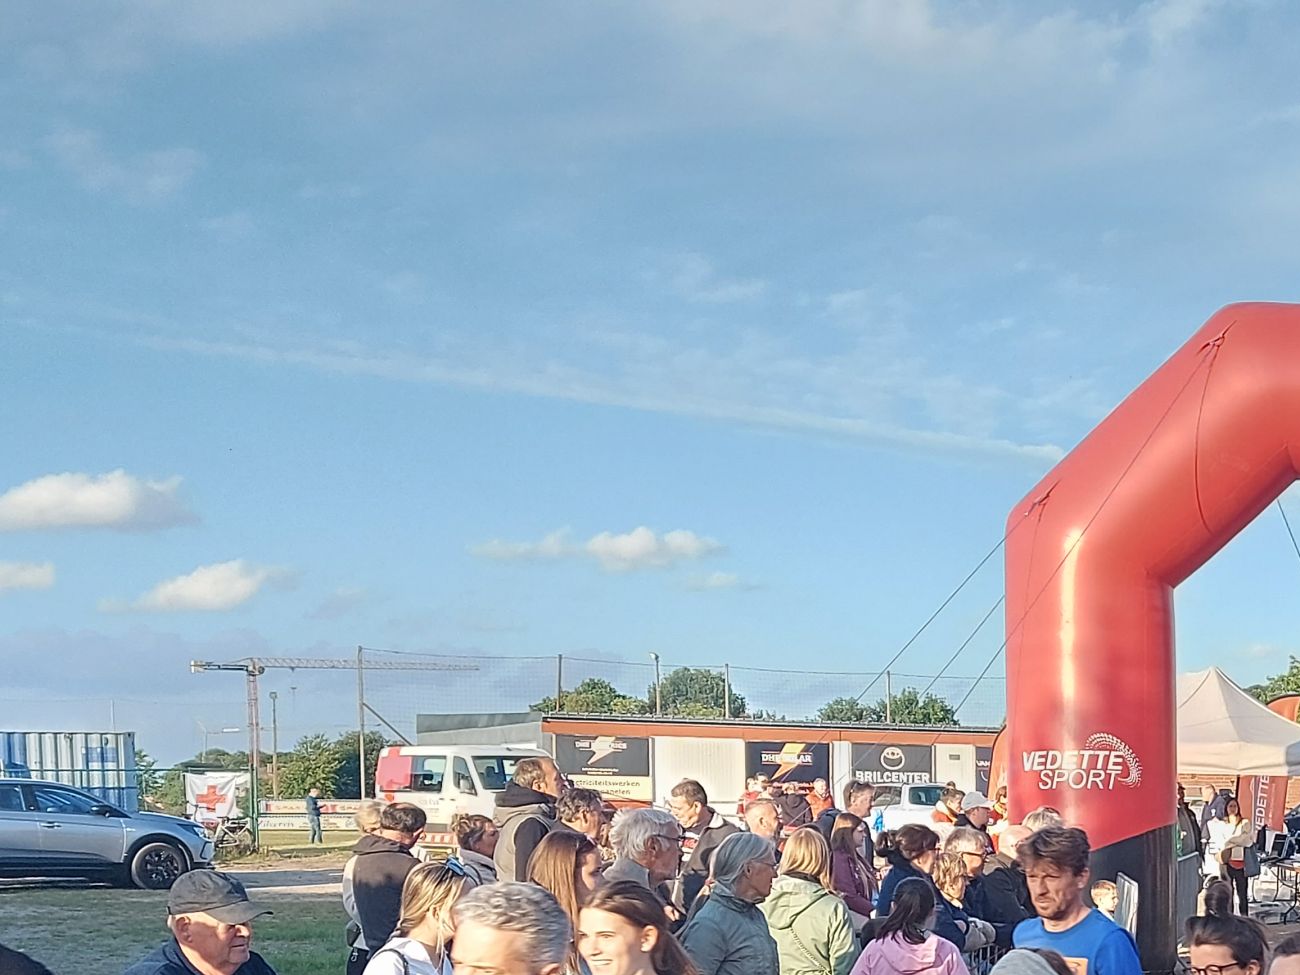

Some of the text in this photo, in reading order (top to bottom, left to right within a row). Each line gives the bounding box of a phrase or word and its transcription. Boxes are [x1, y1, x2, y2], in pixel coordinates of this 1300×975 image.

[1022, 750, 1124, 771] VEDETTE
[855, 770, 930, 783] BRILCENTER
[1038, 769, 1121, 790] SPORT
